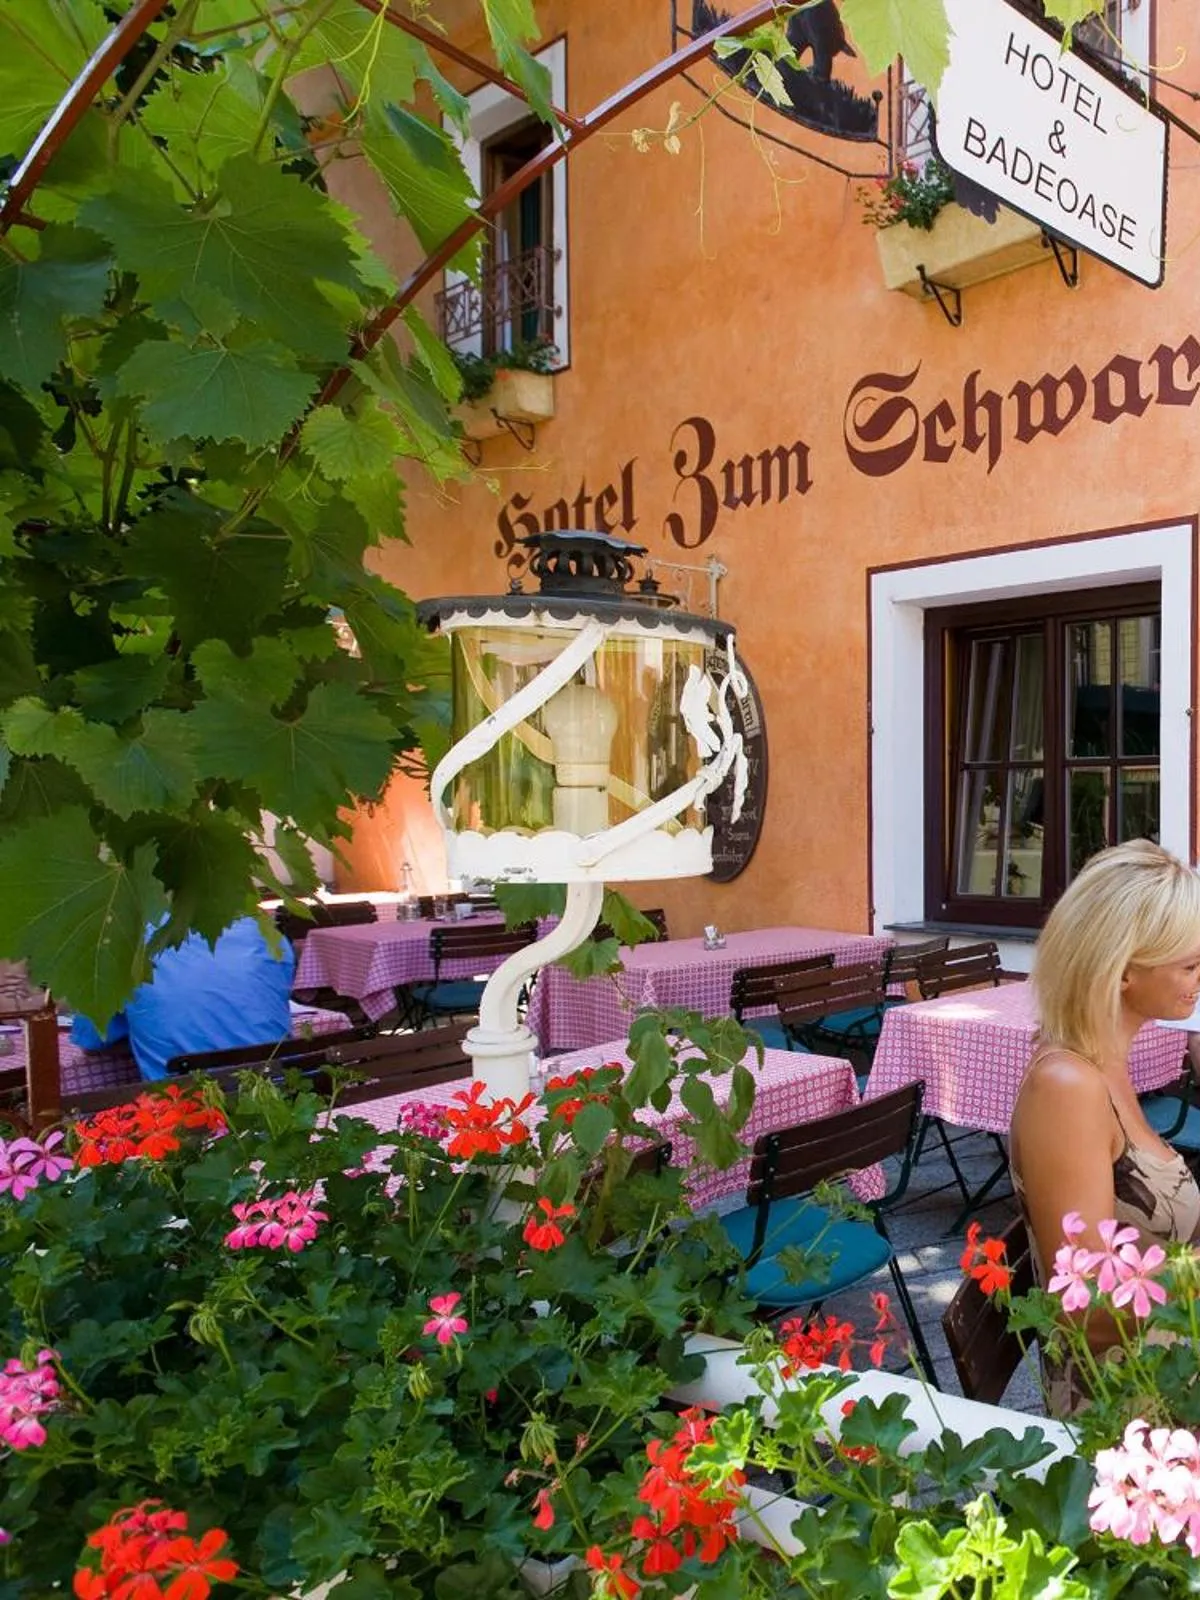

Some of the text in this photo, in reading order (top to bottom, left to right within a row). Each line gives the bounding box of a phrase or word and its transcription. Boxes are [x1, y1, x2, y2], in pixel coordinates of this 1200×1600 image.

[1004, 32, 1108, 135] HOTEL
[1048, 119, 1066, 158] &
[964, 117, 1137, 250] BADEOASE
[494, 456, 639, 577] Hotel
[662, 416, 814, 549] Zum
